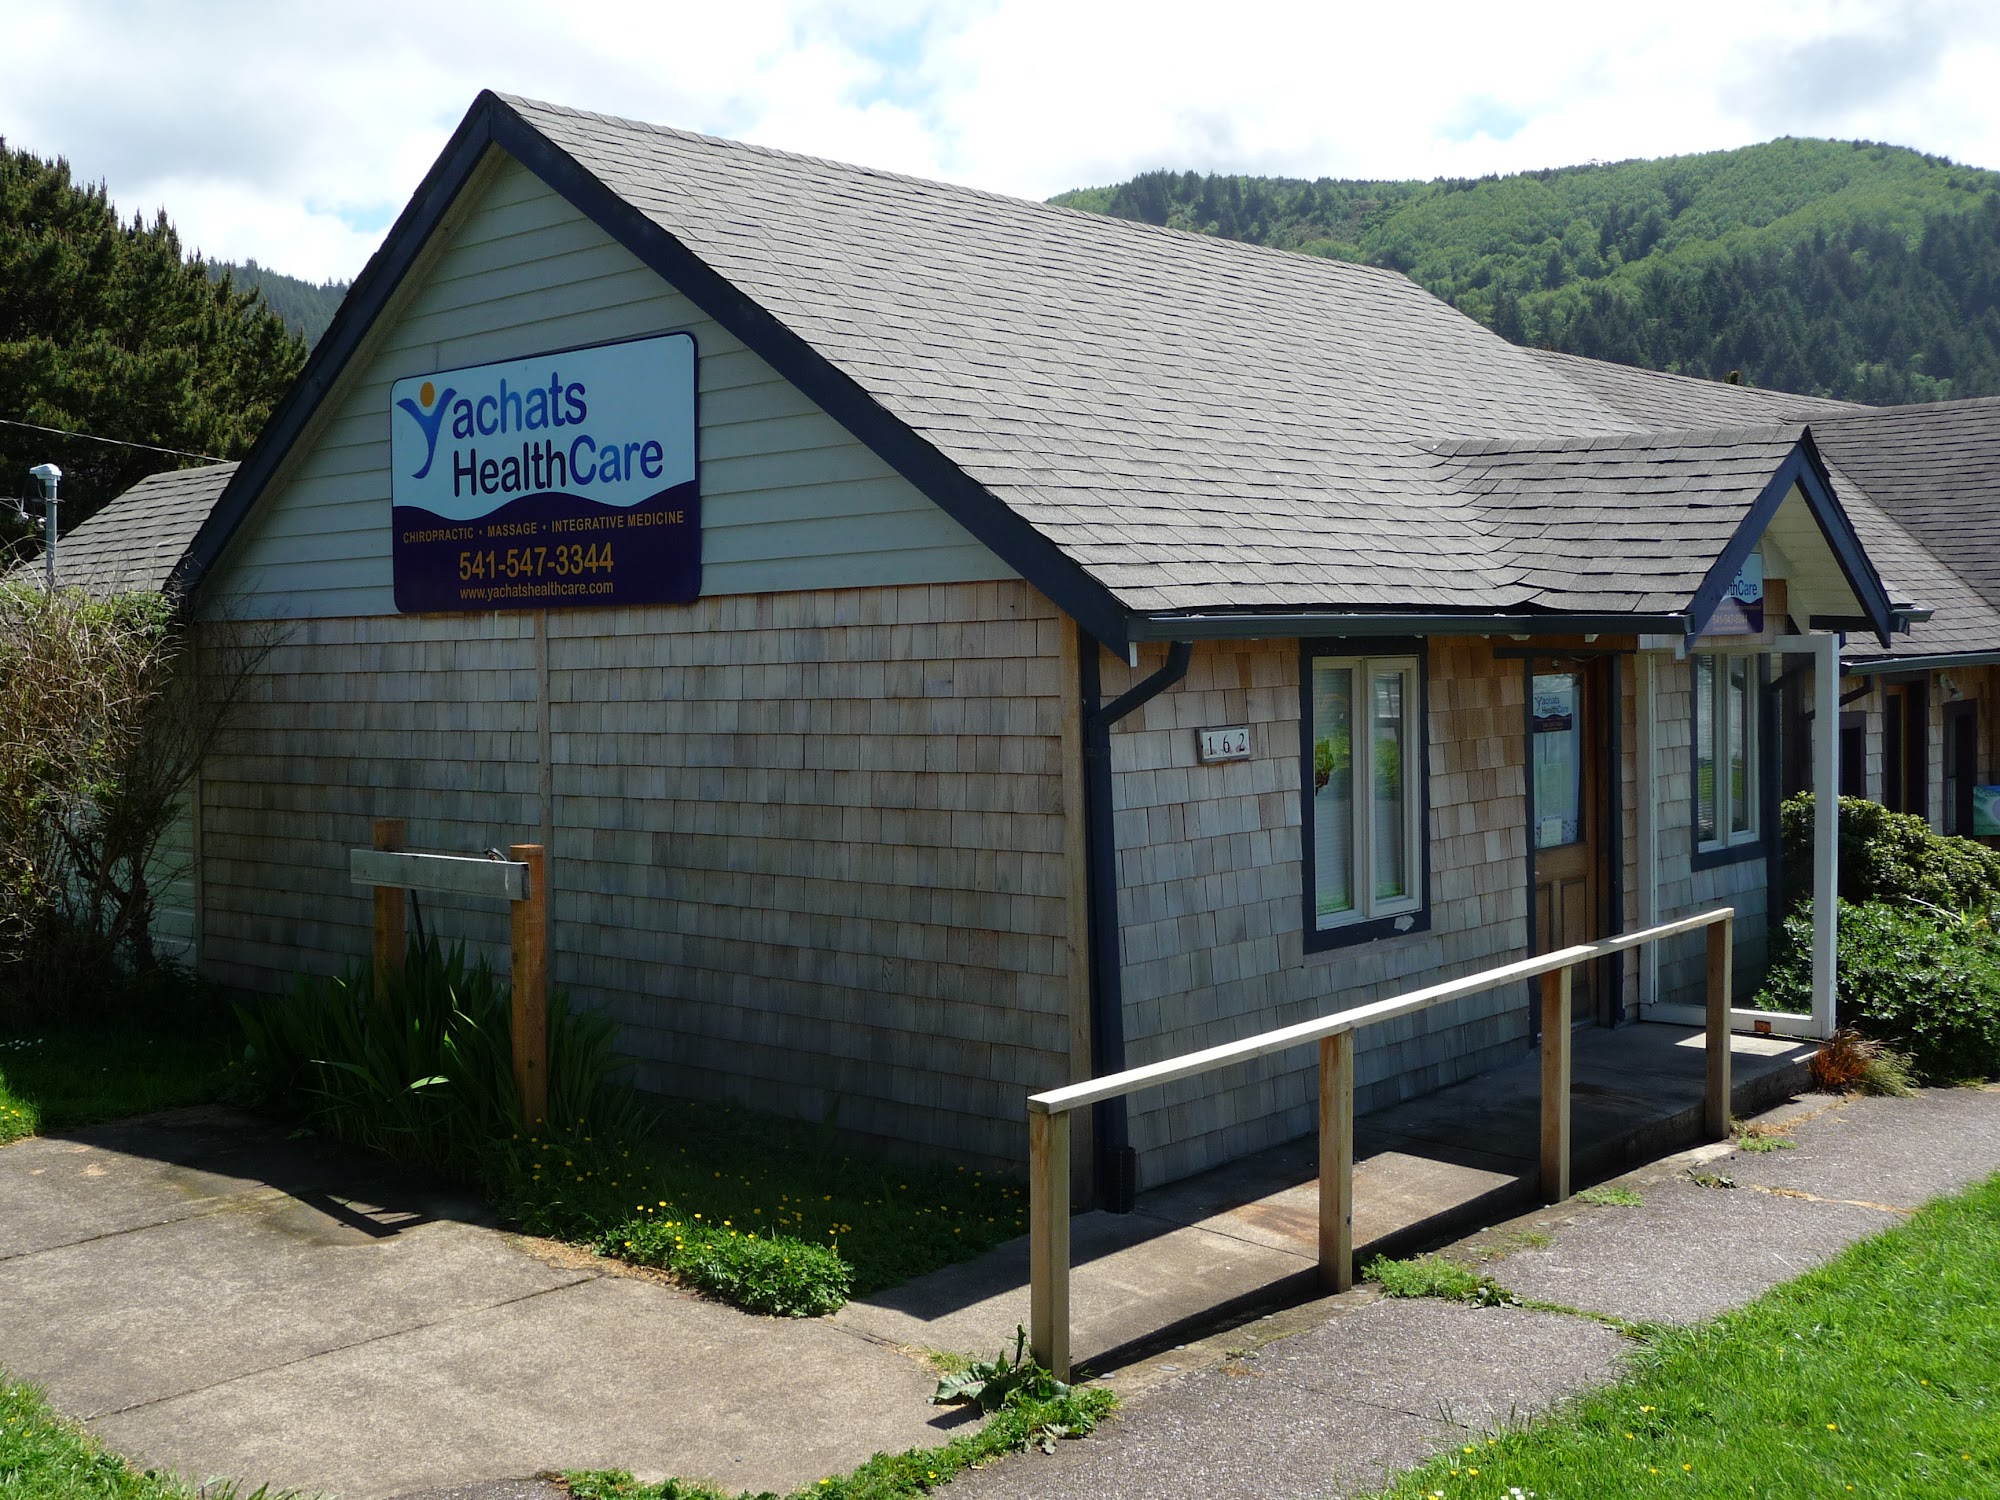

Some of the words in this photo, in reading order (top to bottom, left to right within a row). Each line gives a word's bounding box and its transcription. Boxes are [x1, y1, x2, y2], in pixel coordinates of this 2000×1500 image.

[396, 371, 588, 480] Yachats
[453, 434, 664, 498] HealthCare
[402, 526, 475, 544] CHIROPRACTIC
[486, 522, 538, 538] MASSAGE
[551, 515, 624, 533] INTEGRATIVE
[627, 510, 684, 527] MEDICINE
[459, 542, 614, 581] 541-547-3344
[460, 581, 614, 601] www.yachatshealthcare.com
[1207, 732, 1246, 756] 162
